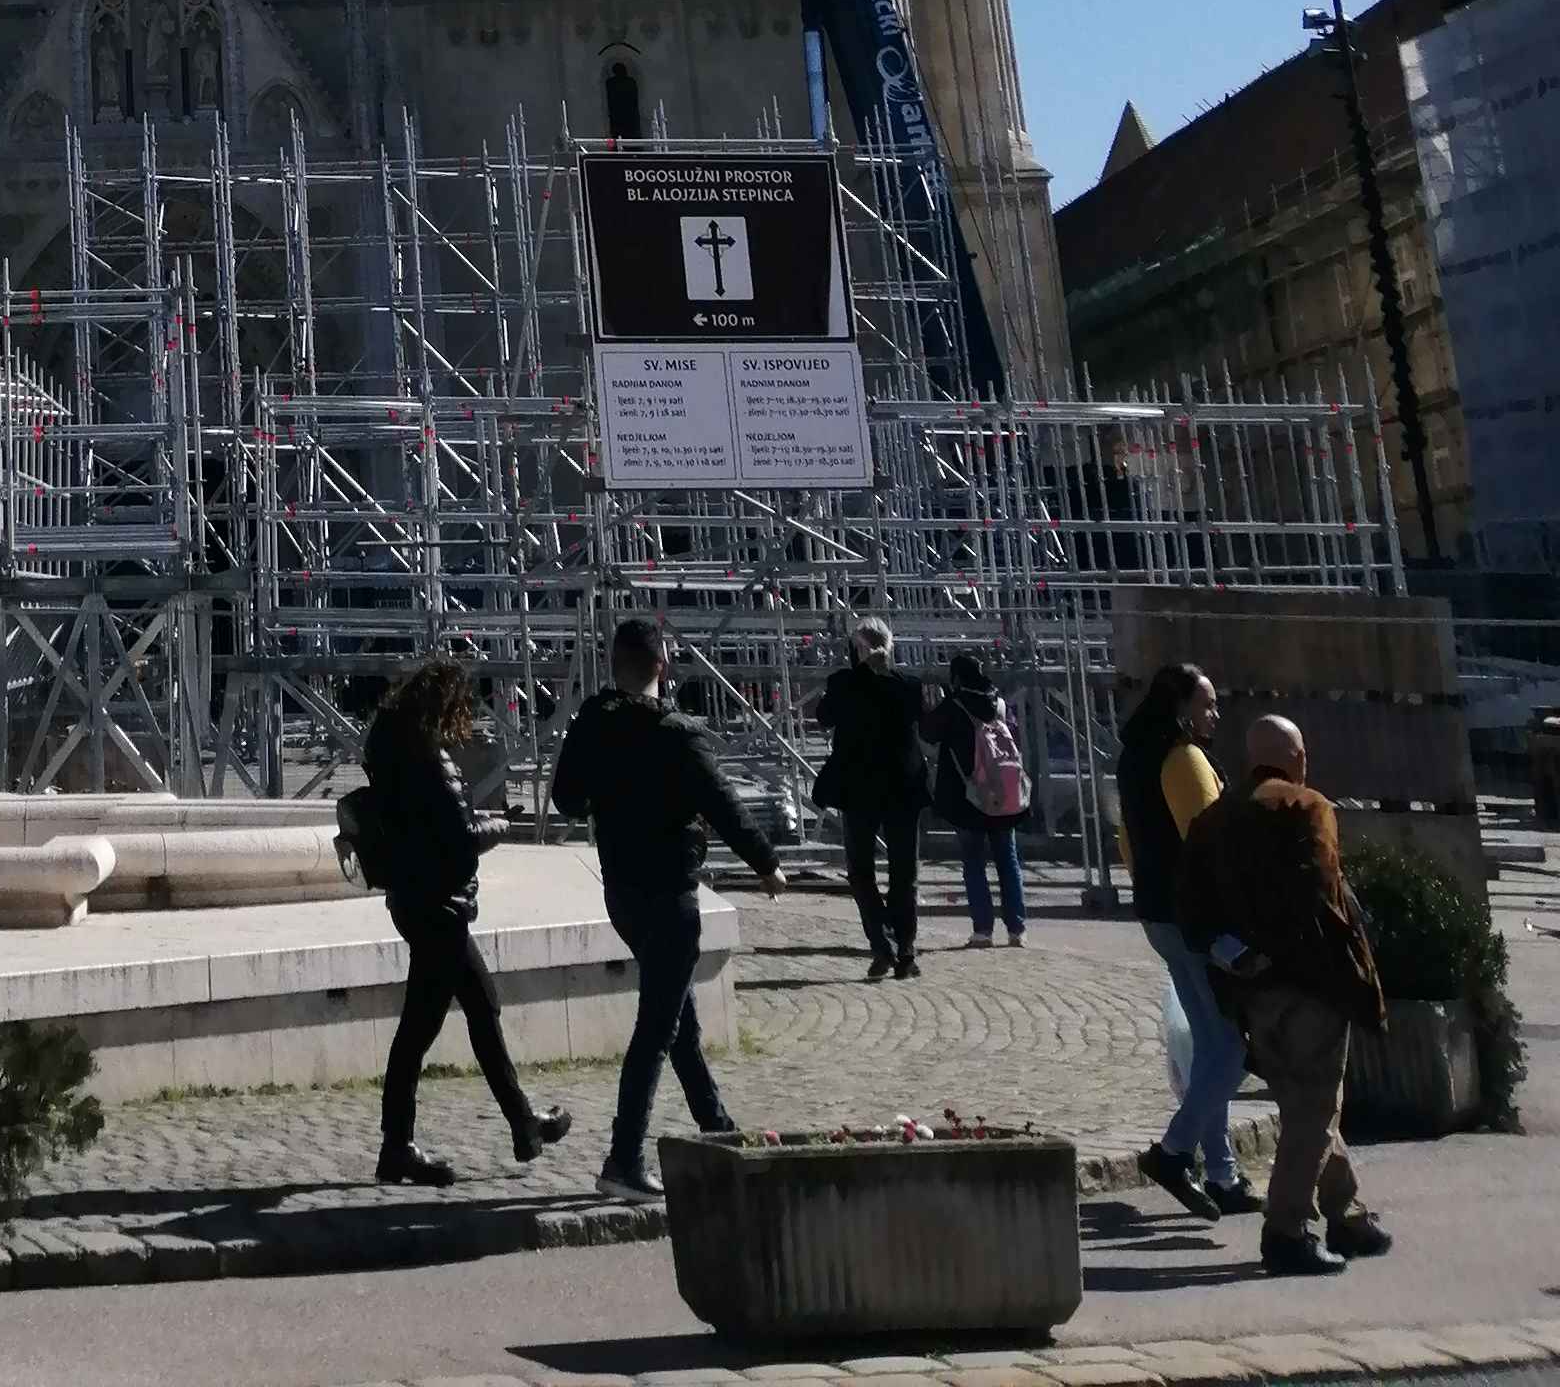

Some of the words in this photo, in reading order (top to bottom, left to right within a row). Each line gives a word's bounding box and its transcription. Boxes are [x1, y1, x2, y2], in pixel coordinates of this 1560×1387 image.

[624, 167, 720, 183] BOGOSLUŽNI
[725, 170, 793, 183] PROSTOR
[627, 188, 648, 201] BL.
[652, 188, 719, 201] ALOJZIJA
[722, 188, 794, 201] STEPINCA
[711, 313, 738, 327] 100
[742, 316, 755, 327] m
[644, 360, 663, 371] SV.
[665, 360, 697, 371] MISE
[743, 359, 761, 370] SV.
[764, 359, 830, 370] ISPOVIJED
[612, 380, 648, 388] RADNIM
[649, 380, 683, 388] DANOM
[617, 433, 667, 442] NEDJELJOM
[746, 433, 796, 441] NEDJELJOM
